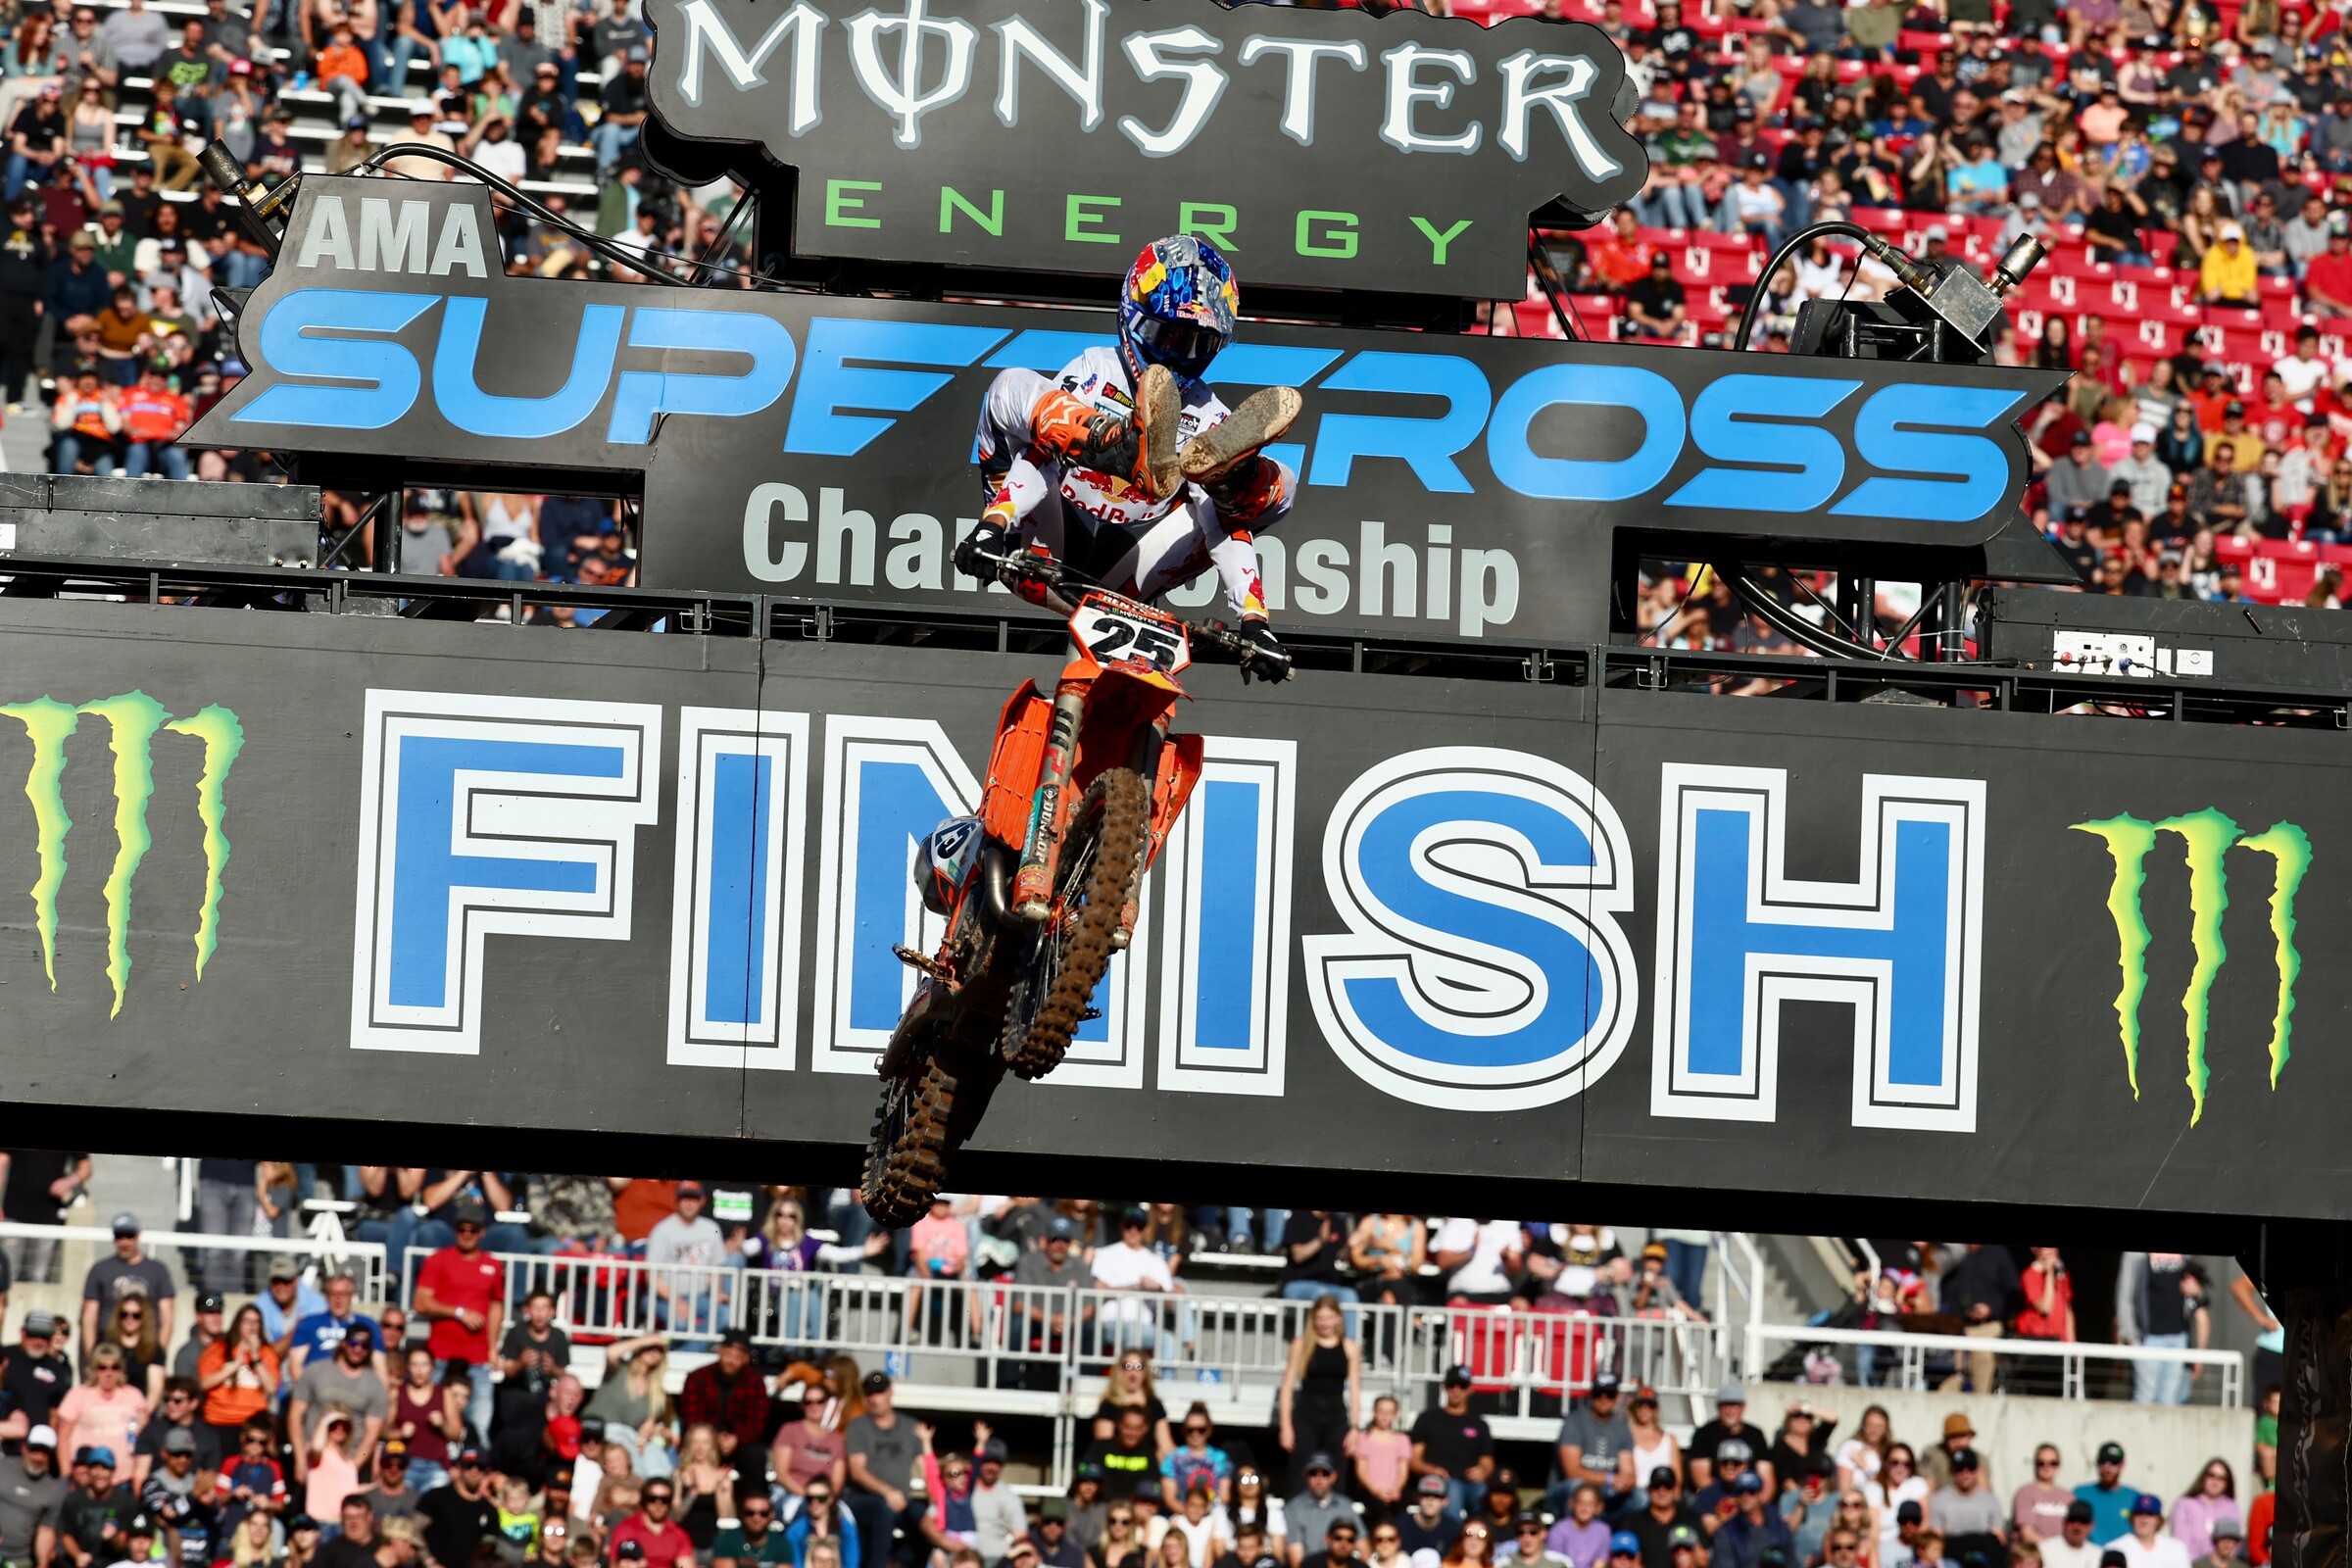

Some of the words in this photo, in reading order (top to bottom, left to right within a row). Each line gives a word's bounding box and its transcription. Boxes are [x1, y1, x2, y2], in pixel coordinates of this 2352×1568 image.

[676, 0, 1625, 183] MONSTER
[296, 195, 488, 278] AMA
[825, 179, 1473, 266] ENERGY
[742, 480, 1521, 638] Chanship
[1089, 617, 1181, 672] 25
[1036, 801, 1055, 864] DUNLOP
[349, 687, 1987, 1133] FINISH
